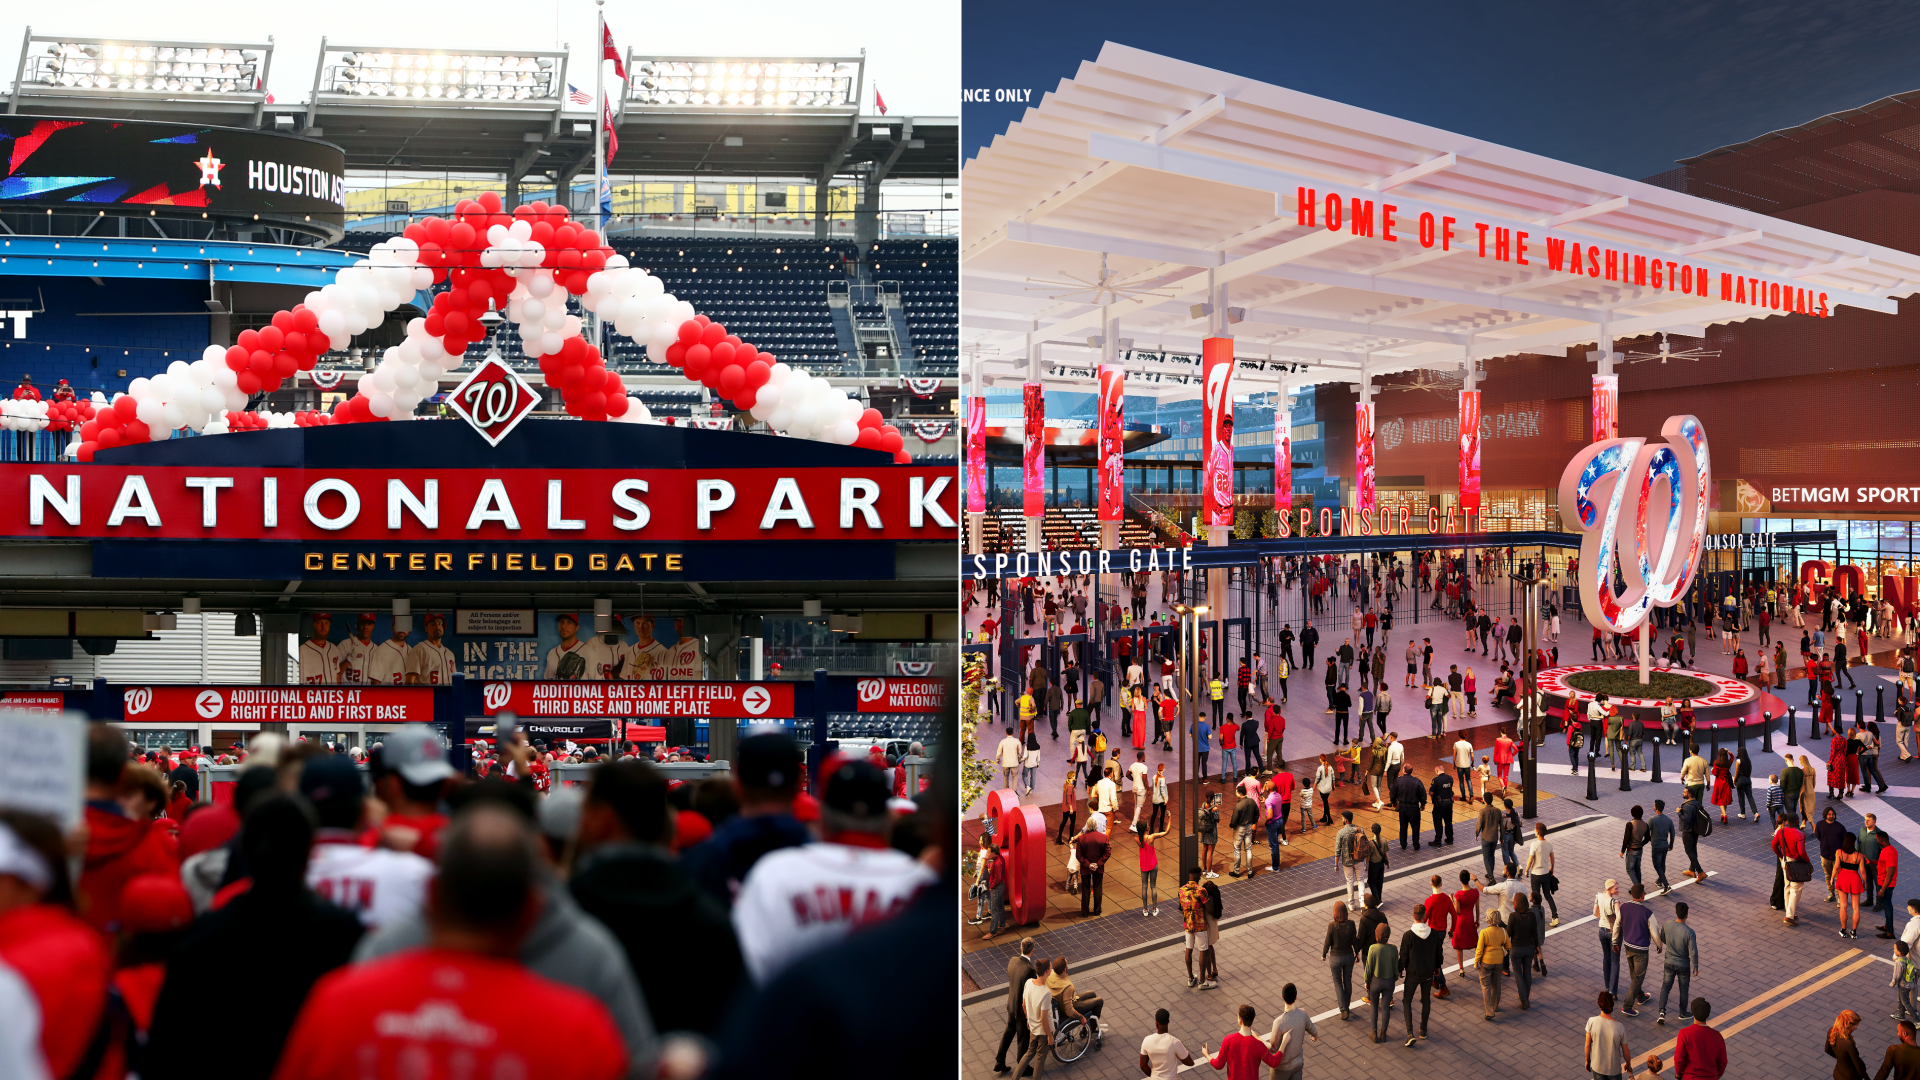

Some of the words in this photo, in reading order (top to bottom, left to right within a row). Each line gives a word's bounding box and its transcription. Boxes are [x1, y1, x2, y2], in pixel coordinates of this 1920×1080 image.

[248, 159, 329, 201] HOUSTON
[391, 203, 405, 211] 418
[1297, 187, 1397, 242] HOME
[1419, 212, 1456, 251] OF
[1475, 222, 1529, 265] THE
[1546, 236, 1708, 297] WASHINGTON
[1720, 272, 1828, 319] NATIONALS
[464, 373, 519, 429] W
[1412, 416, 1492, 444] NATIONS
[1496, 410, 1540, 439] PARK
[29, 474, 651, 531] NATIONALS
[696, 476, 958, 530] PARK
[1772, 487, 1849, 503] BETMGM
[1856, 487, 1920, 503] SPORT
[1277, 506, 1411, 538] SPONSOR
[1427, 506, 1488, 534] GATE
[1558, 414, 1711, 633] W
[1750, 532, 1777, 548] GATE
[304, 552, 454, 571] CENTER
[467, 552, 574, 571] FIELD
[588, 553, 683, 571] GATE
[974, 550, 1111, 579] SPONSOR
[1130, 547, 1193, 573] GATE
[463, 642, 488, 662] IN
[494, 642, 539, 662] THE
[430, 671, 439, 684] 6
[670, 668, 694, 676] ONE
[230, 690, 303, 704] ADDITIONAL
[306, 690, 344, 704] GATES
[347, 690, 362, 704] AT
[533, 685, 604, 698] ADDITIONAL
[607, 685, 646, 699] GATES
[649, 685, 664, 699] AT
[667, 685, 695, 699] LEFT
[698, 686, 737, 702] FIELD,
[889, 684, 945, 695] WELCOME
[230, 705, 268, 719] RIGHT
[270, 705, 306, 719] FIELD
[309, 705, 334, 719] AND
[338, 705, 373, 719] FIRST
[376, 705, 407, 719] BASE
[533, 700, 570, 714] THIRD
[573, 700, 604, 714] BASE
[607, 700, 632, 714] AND
[636, 701, 671, 714] HOME
[674, 701, 711, 715] PLATE
[529, 725, 585, 733] CHEVROLET
